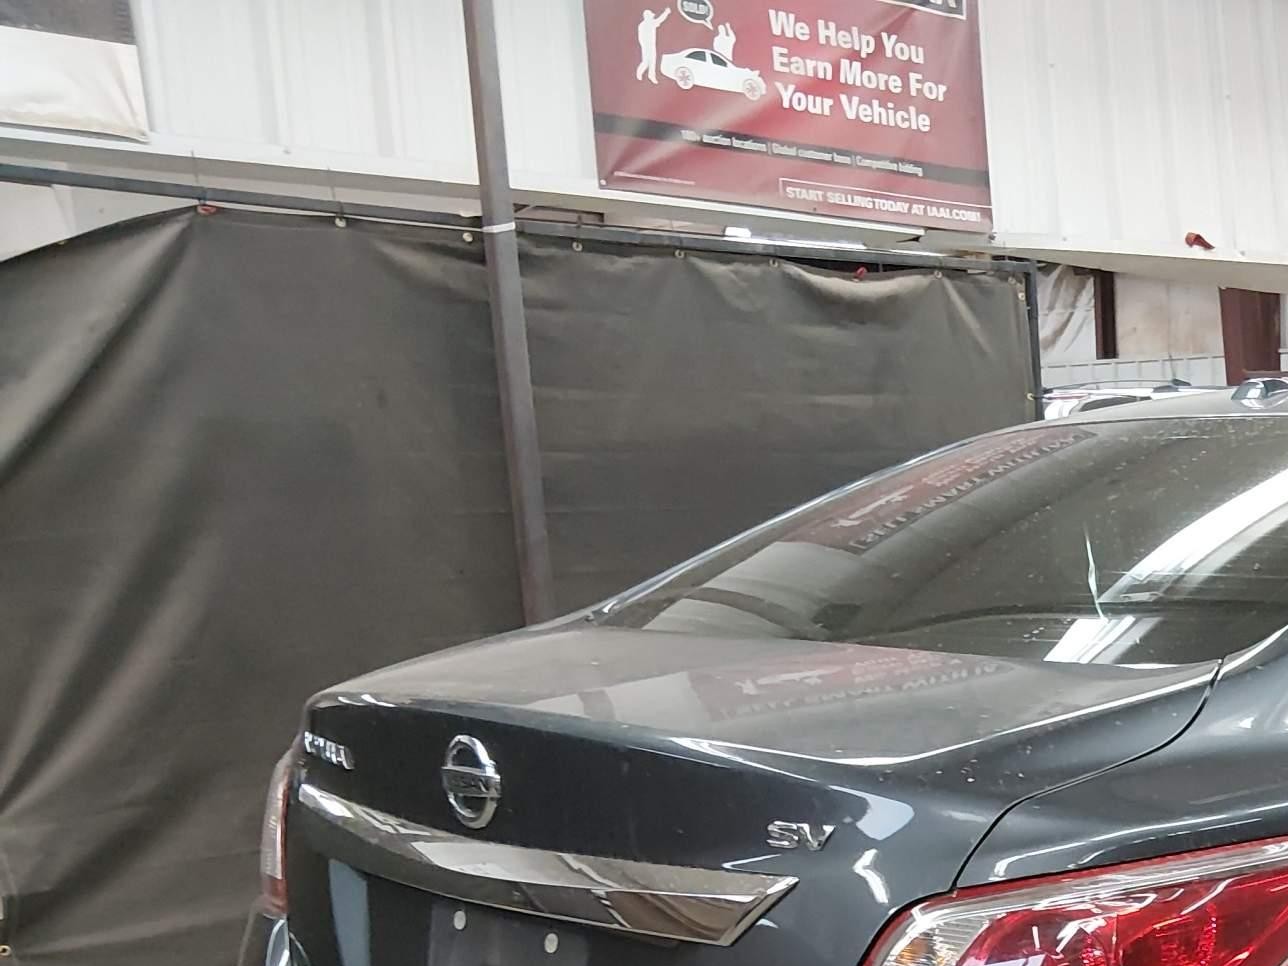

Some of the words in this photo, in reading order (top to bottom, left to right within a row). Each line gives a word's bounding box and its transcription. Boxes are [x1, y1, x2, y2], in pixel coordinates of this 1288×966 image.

[768, 9, 810, 41] We
[817, 19, 876, 58] Help
[881, 32, 925, 64] You
[772, 46, 833, 80] Earn
[839, 58, 903, 93] More
[908, 72, 947, 102] For
[775, 82, 833, 116] Your
[839, 94, 931, 132] Vehicle
[786, 187, 824, 201] START
[874, 197, 909, 213] TODAY
[911, 204, 926, 215] AT
[766, 820, 836, 851] SV
